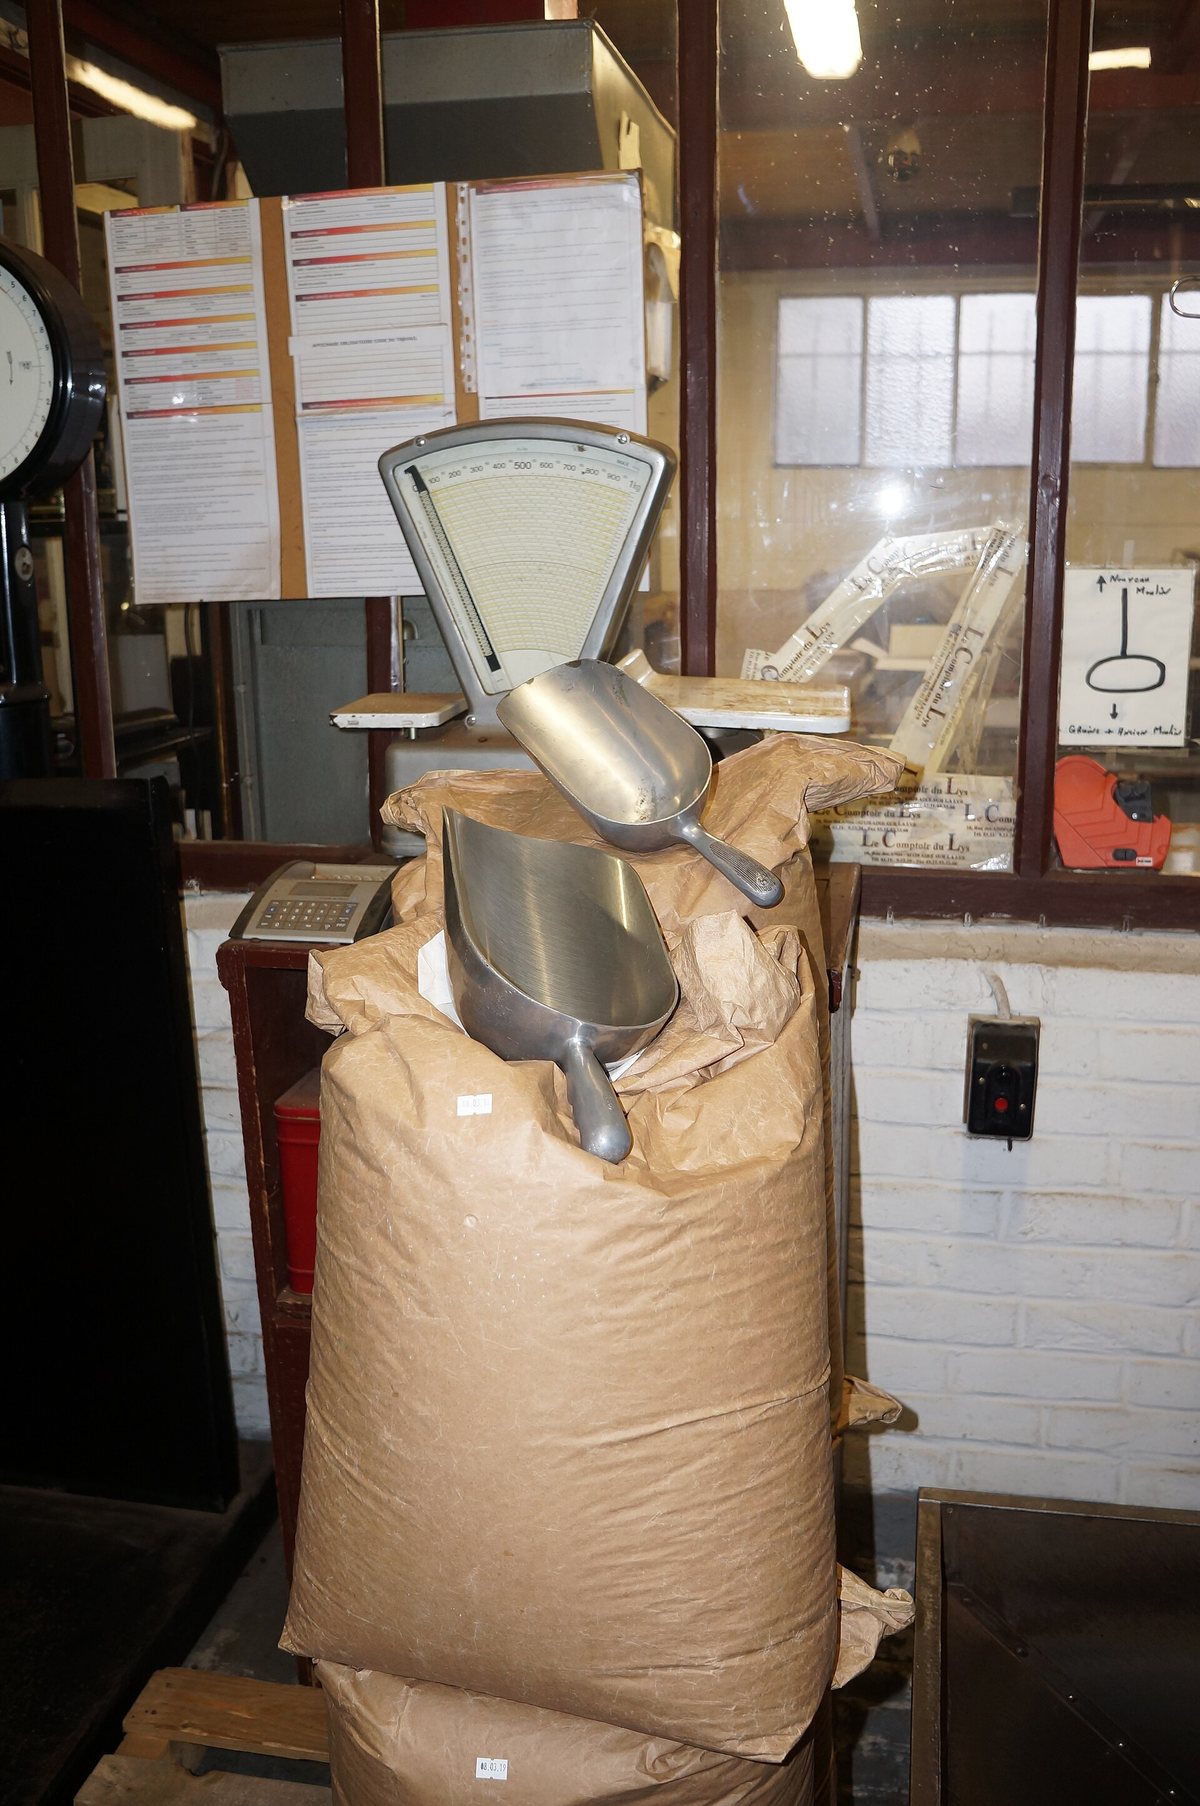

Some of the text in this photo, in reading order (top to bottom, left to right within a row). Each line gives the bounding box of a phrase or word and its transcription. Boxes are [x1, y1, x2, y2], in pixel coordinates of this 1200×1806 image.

[428, 475, 441, 484] 100
[448, 470, 462, 479] 200
[469, 465, 484, 474] 300
[492, 462, 506, 470] 400
[513, 460, 532, 470] 500
[563, 463, 577, 472] 700
[585, 467, 600, 476] 800
[606, 472, 621, 482] 900
[805, 622, 831, 641] Lys
[961, 626, 984, 643] Le
[932, 692, 942, 705] du
[921, 706, 947, 728] Lys
[930, 784, 943, 795] du
[945, 776, 969, 797] Lys
[883, 807, 895, 818] du
[860, 828, 970, 853] Le Comptoir du Lys
